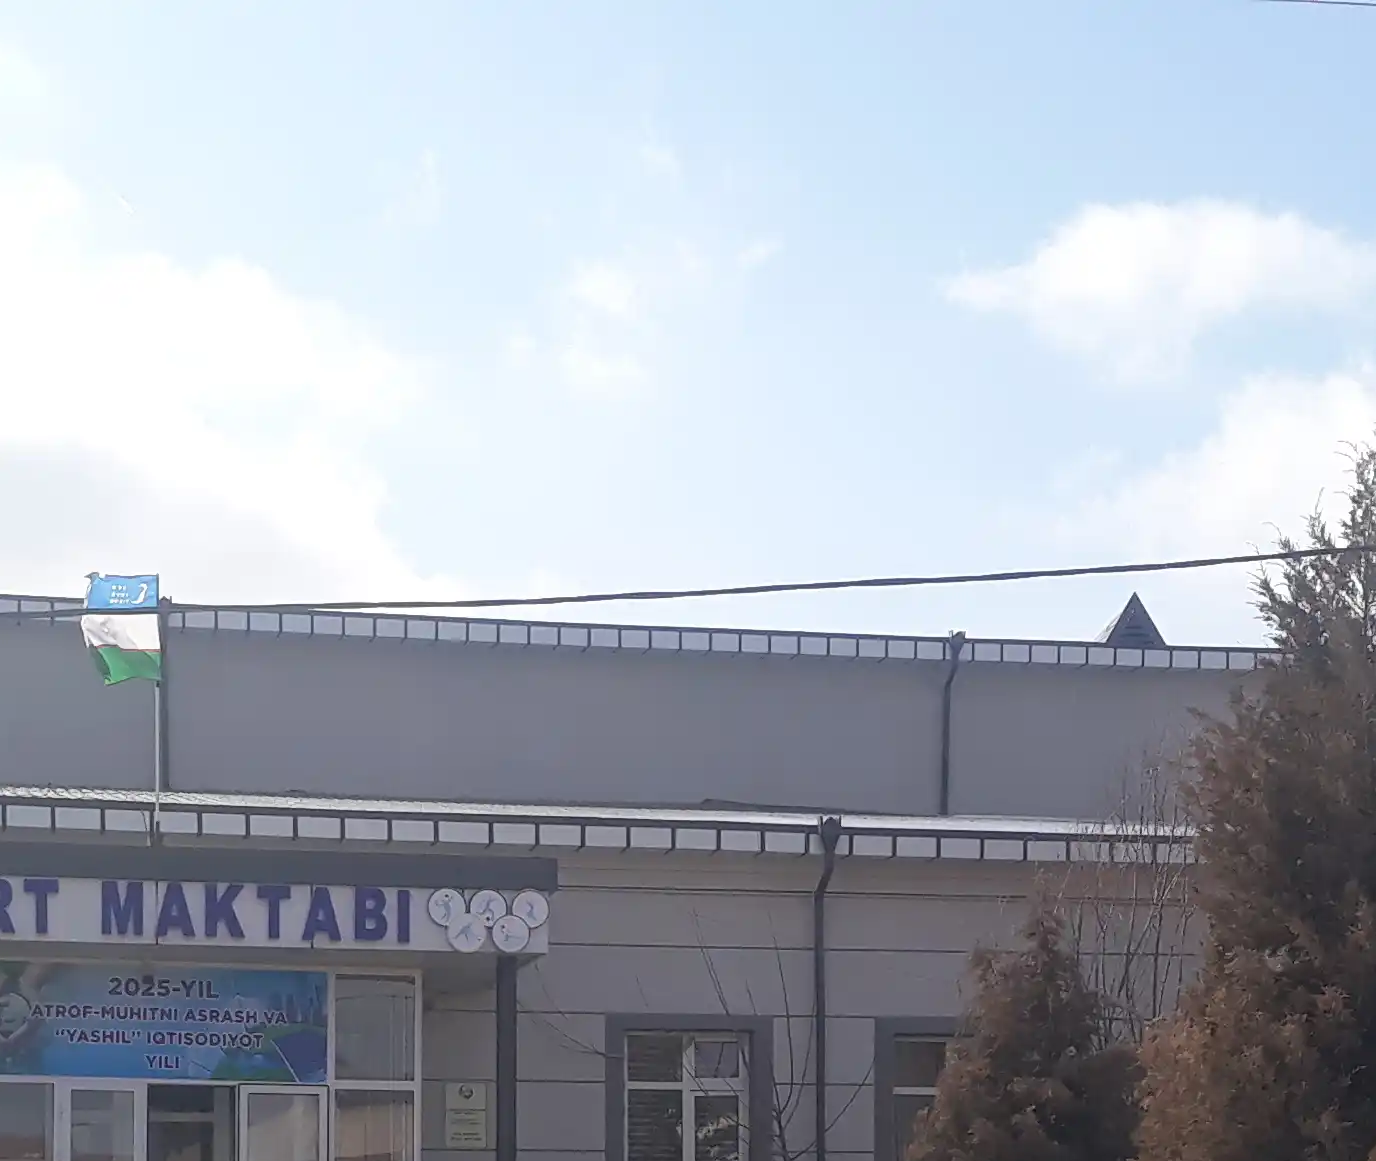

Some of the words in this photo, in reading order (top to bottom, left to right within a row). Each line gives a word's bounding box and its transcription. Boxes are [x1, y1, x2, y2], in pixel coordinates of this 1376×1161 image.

[101, 880, 412, 944] MAKTABI
[108, 977, 219, 999] 2025-YIL
[30, 1004, 178, 1021] ATROF-MUHITNI
[184, 1008, 258, 1024] ASRASH
[264, 1010, 287, 1024] VA
[147, 1031, 263, 1048] IQTISODIYOT
[145, 1055, 180, 1069] YILI
